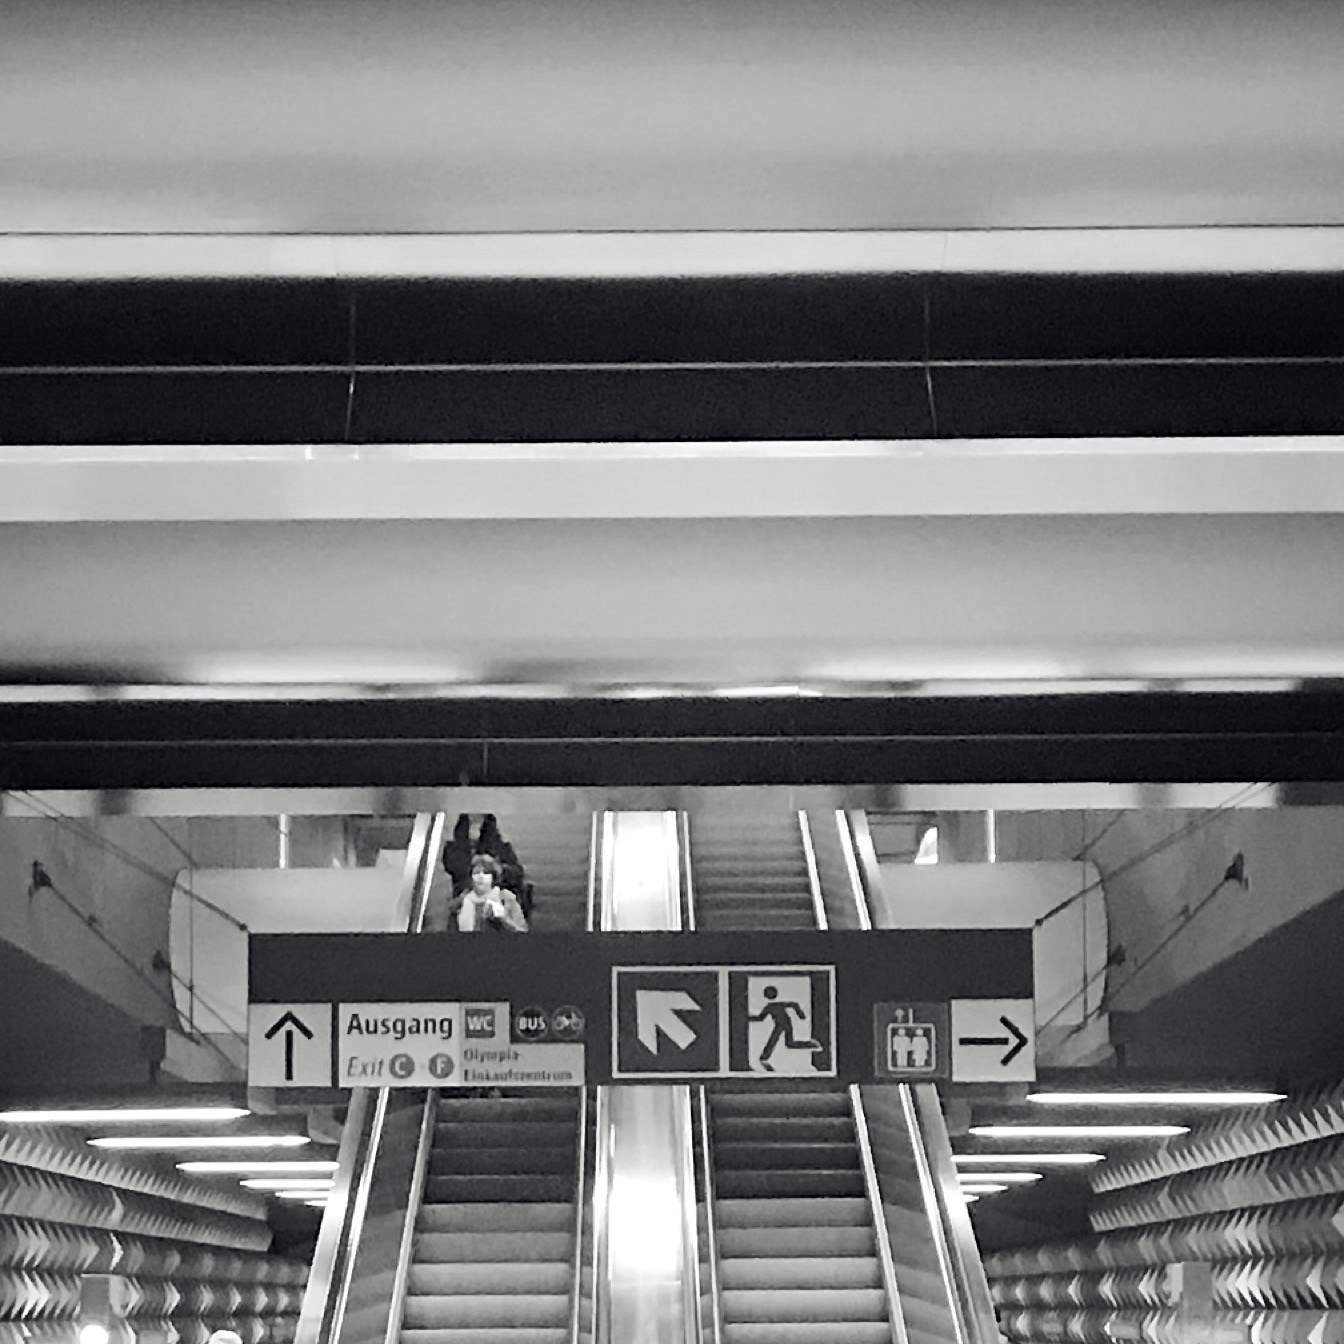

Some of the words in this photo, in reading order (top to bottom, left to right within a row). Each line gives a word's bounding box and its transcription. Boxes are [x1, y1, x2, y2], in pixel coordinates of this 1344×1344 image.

[346, 1012, 454, 1041] Ausgang
[467, 1014, 494, 1032] WC
[518, 1016, 547, 1032] BUS
[346, 1055, 385, 1077] Exit
